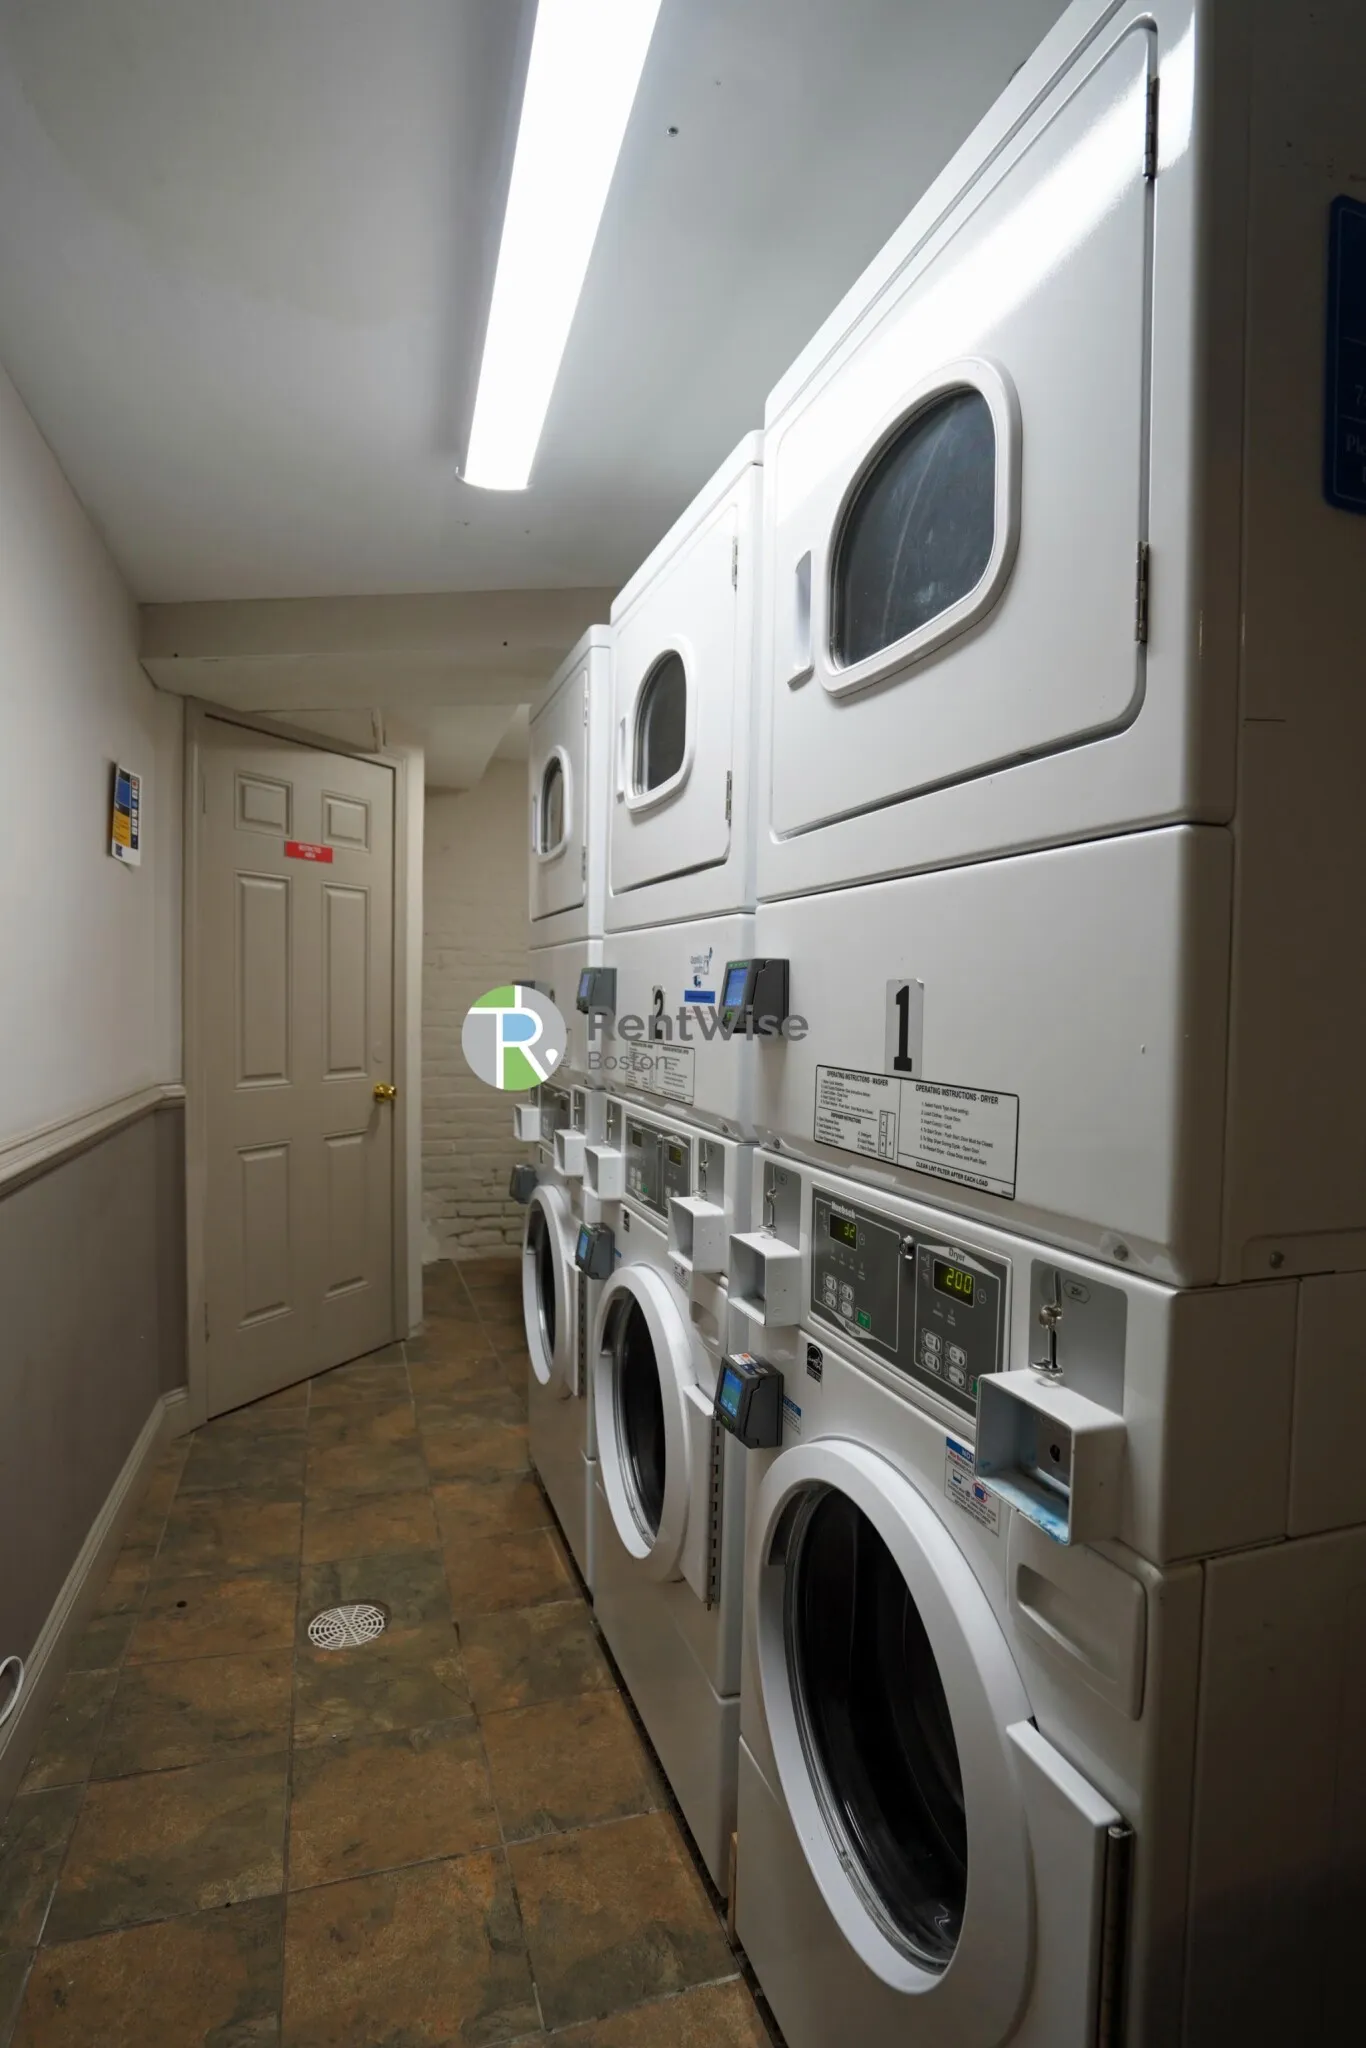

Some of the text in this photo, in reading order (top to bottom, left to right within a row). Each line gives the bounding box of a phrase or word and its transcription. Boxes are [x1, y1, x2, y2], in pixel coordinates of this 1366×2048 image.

[654, 989, 664, 1040] 2
[894, 985, 912, 1072] 1
[826, 1071, 844, 1079] OPERATING
[845, 1074, 869, 1083] INSTRUCTIONS
[872, 1078, 888, 1086] WASHER
[915, 1084, 940, 1095] OPERATING
[941, 1089, 976, 1101] INSTRUCTIONS
[980, 1095, 998, 1104] DRYER
[915, 1161, 928, 1169] CLEAN
[937, 1167, 950, 1176] FILTER
[950, 1171, 963, 1180] AFTER
[964, 1175, 975, 1183] EACH
[975, 1178, 988, 1187] LOAD
[948, 1248, 965, 1263] Dryer
[946, 1267, 972, 1294] 200
